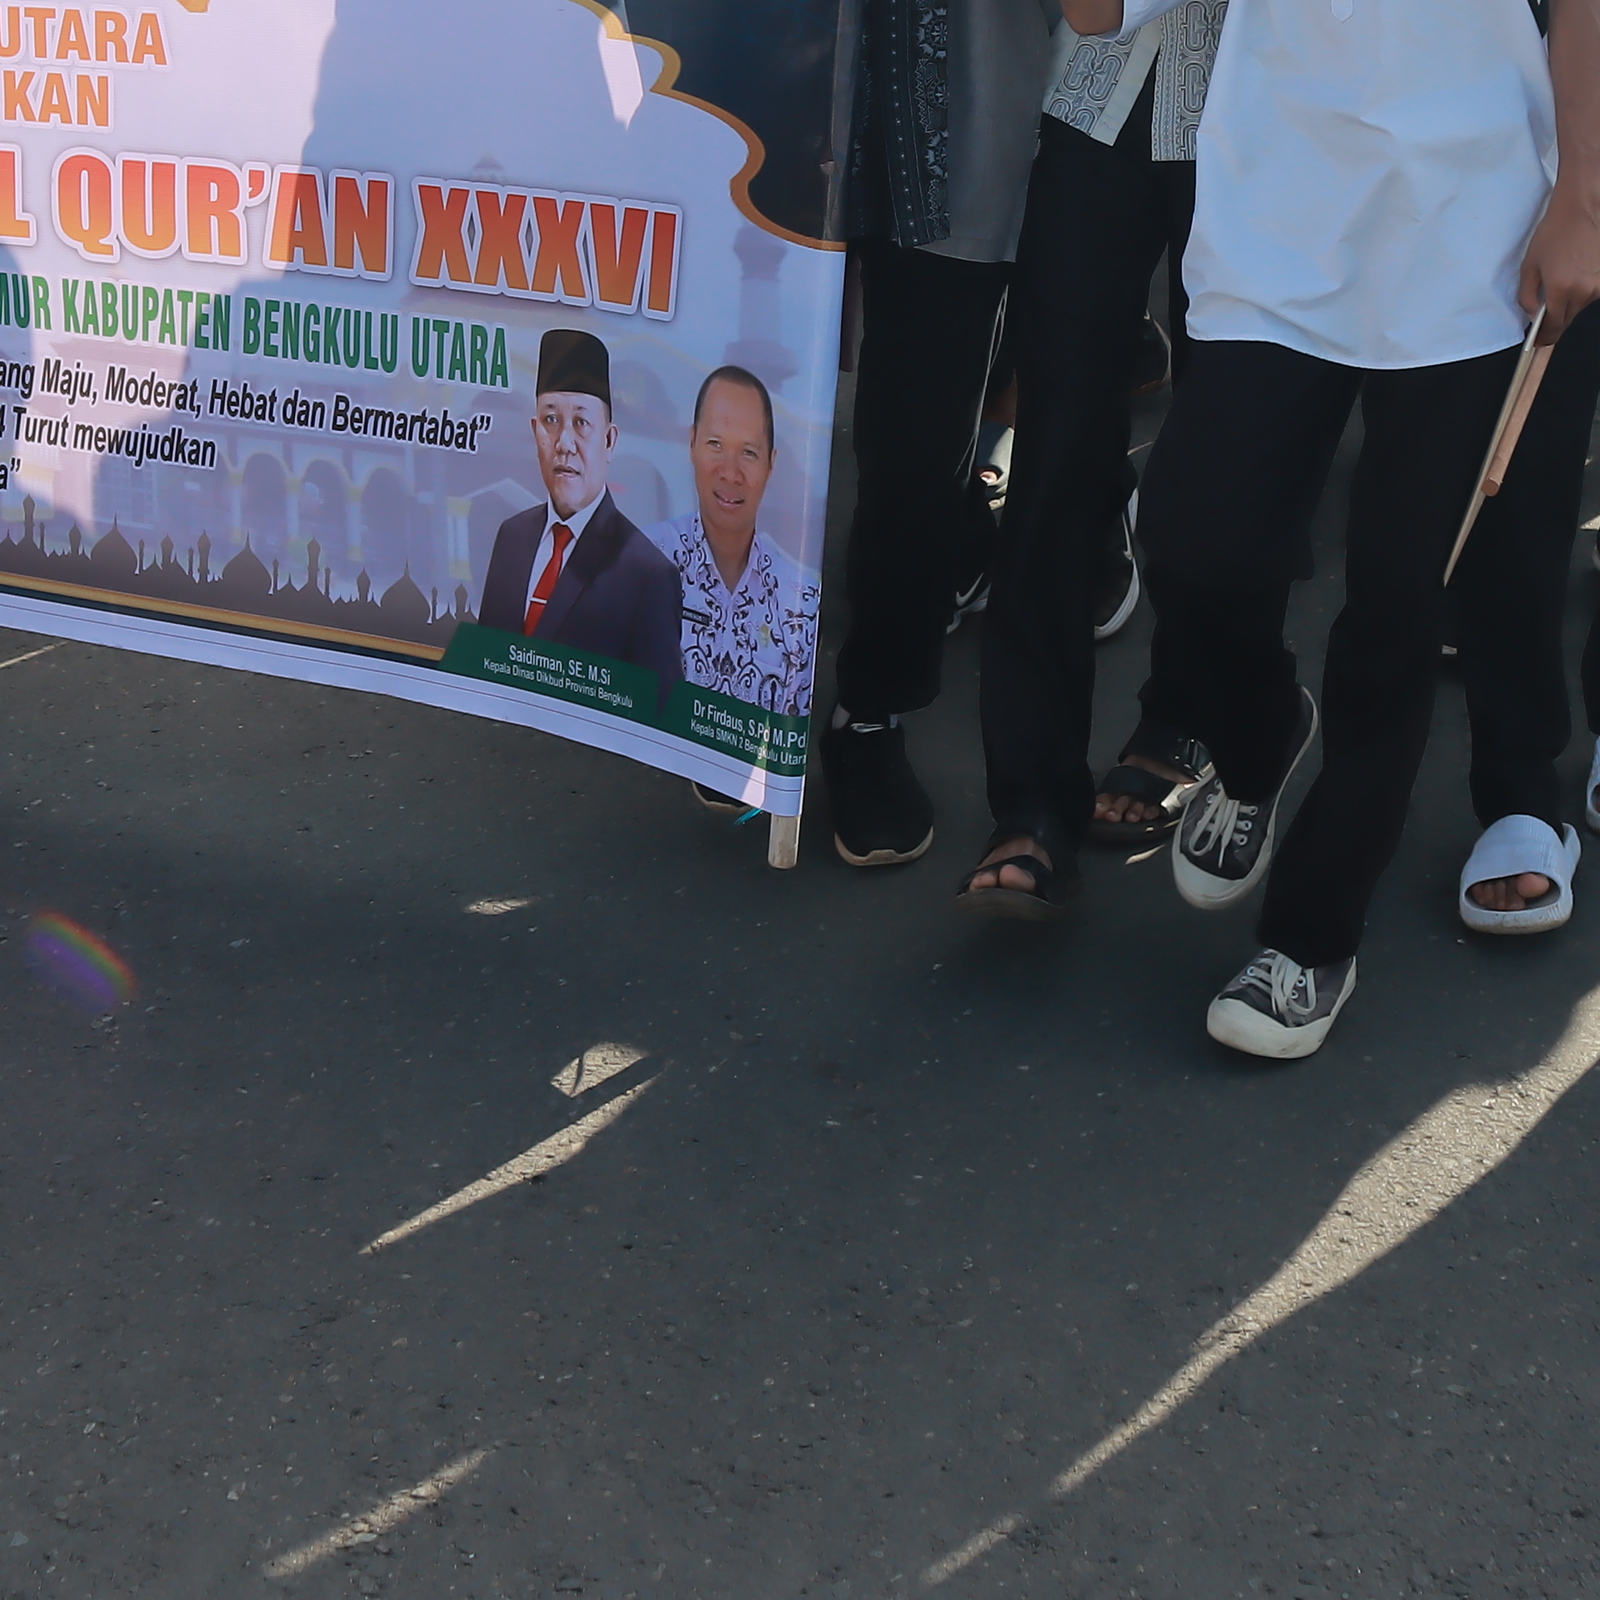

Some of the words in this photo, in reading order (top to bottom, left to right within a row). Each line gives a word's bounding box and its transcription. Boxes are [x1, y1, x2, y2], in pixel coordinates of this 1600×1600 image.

[57, 152, 390, 273] QUR'AN
[415, 185, 677, 312] XXXVI
[61, 278, 232, 352] KABUPATEN
[243, 298, 399, 375] BENGKULU
[411, 317, 510, 388] UTARA
[40, 357, 98, 406] Maju,
[105, 366, 203, 418] Moderat,
[207, 379, 278, 424] Hebat
[281, 389, 326, 432] dan
[12, 407, 68, 450] Turut
[73, 413, 217, 470] mewujudkan
[483, 658, 511, 674] Kepala
[512, 665, 534, 680] Dinas
[536, 670, 563, 688] Dikbud
[565, 678, 596, 697] Provinsi
[598, 687, 633, 708] Bengkulu
[509, 645, 565, 675] Saidirman,
[568, 659, 586, 678] SE.
[588, 665, 611, 685] M.Si
[690, 719, 715, 738] Kepala
[716, 727, 738, 747] SMKN
[739, 737, 744, 748] 2
[745, 739, 778, 761] Bengkulu
[694, 699, 705, 717] Dr
[707, 704, 746, 736] Firdaus,
[748, 719, 771, 742] S.Pd
[773, 728, 807, 748] M.Pd
